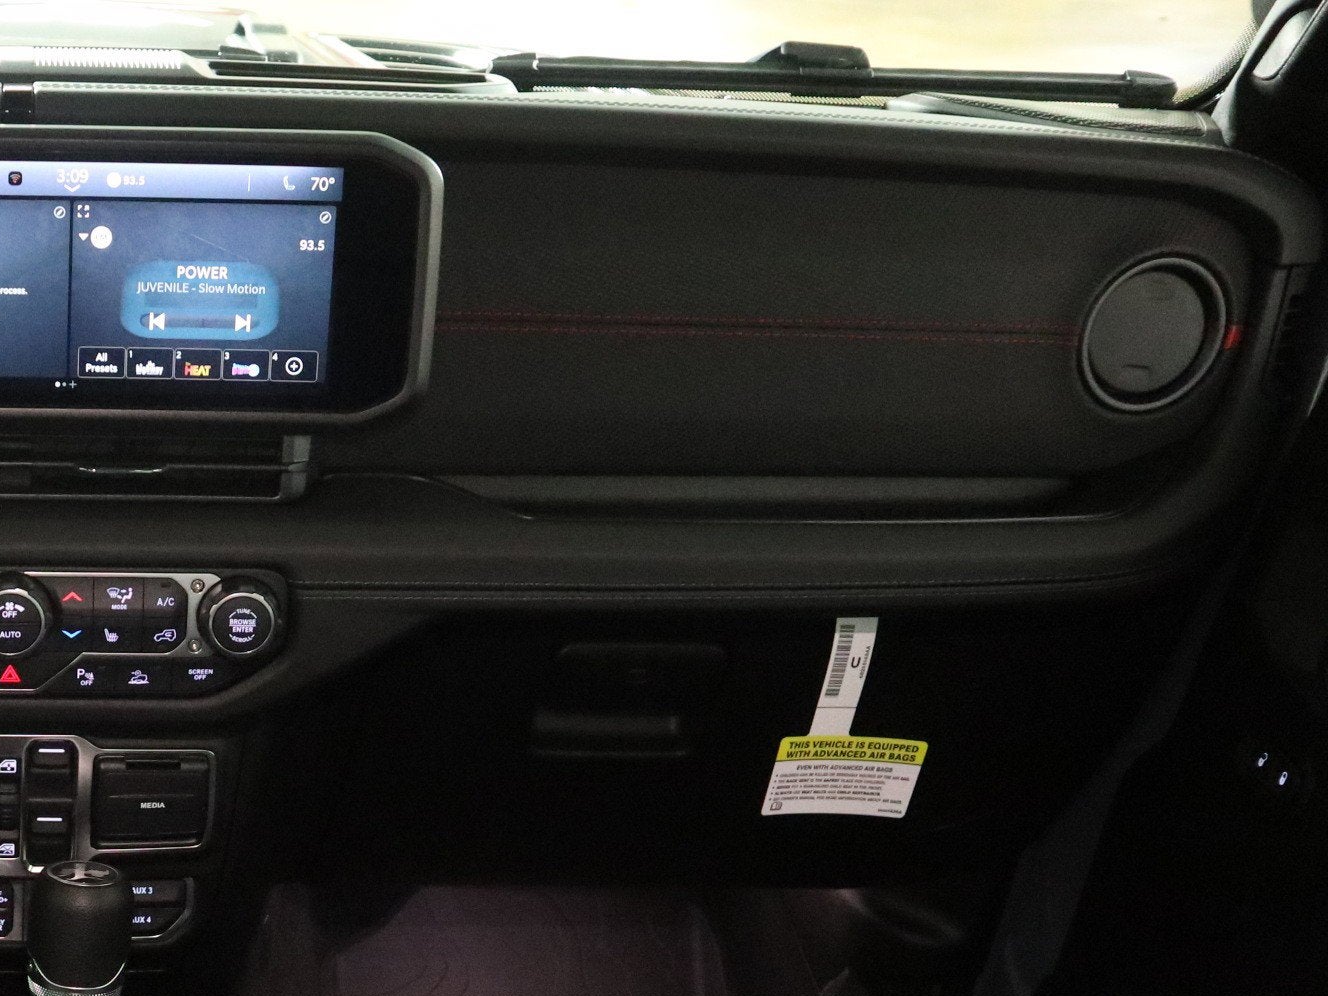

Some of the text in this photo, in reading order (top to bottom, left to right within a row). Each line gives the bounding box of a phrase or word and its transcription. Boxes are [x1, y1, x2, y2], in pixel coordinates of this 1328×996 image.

[56, 168, 89, 183] 3:09
[123, 176, 145, 186] 93.5
[310, 177, 335, 191] 70°
[300, 240, 325, 251] 93.5
[176, 265, 228, 280] POWER
[136, 282, 189, 294] JUVENILE
[198, 283, 225, 294] Slow
[227, 283, 266, 295] Motion
[96, 352, 108, 362] All
[176, 351, 182, 360] 2
[224, 352, 230, 360] 3
[272, 352, 278, 361] 4
[86, 363, 118, 374] Presets
[156, 597, 175, 608] A/C
[2, 610, 18, 618] OFF
[789, 740, 920, 753] THIS VEHICLE IS EQUIPPED
[786, 750, 916, 762] WITH ADVANCED AIR BAGS
[140, 801, 166, 809] MEDIA
